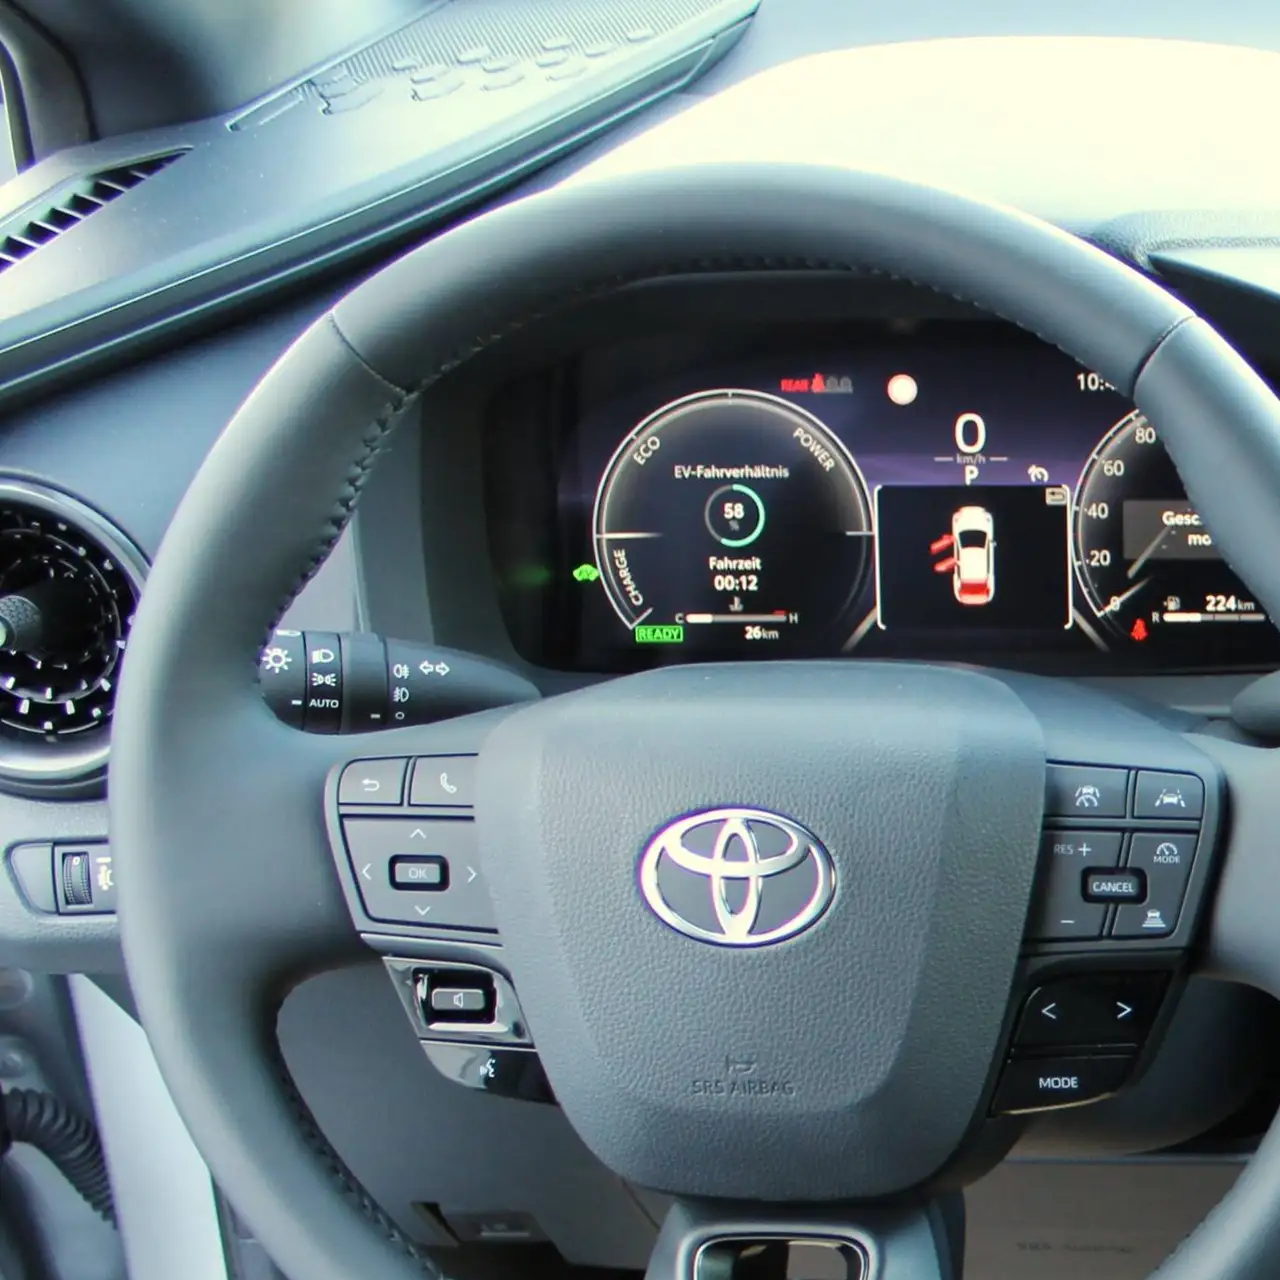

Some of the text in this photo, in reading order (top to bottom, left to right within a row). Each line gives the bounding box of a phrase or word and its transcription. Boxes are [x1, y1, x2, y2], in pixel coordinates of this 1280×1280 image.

[954, 412, 986, 454] 0
[1135, 427, 1156, 444] 80
[632, 435, 661, 465] ECO
[793, 427, 836, 472] POWER
[956, 453, 986, 464] km/h
[674, 464, 790, 480] EV-Fahrverhältnis
[965, 464, 979, 485] P
[1103, 459, 1124, 476] 60
[723, 502, 745, 519] 58
[1088, 503, 1109, 519] 40
[1162, 511, 1203, 526] Gesc
[708, 556, 762, 572] Fahrzeit
[1090, 549, 1111, 566] 20
[612, 549, 644, 606] CHARGE
[713, 575, 759, 591] 00:12
[675, 613, 684, 624] C
[788, 612, 798, 624] H
[1152, 612, 1160, 624] R
[638, 627, 682, 641] READY
[309, 698, 339, 709] AUTO
[1053, 843, 1075, 856] RES
[1153, 855, 1181, 864] MODE
[408, 866, 427, 880] OK
[1092, 881, 1134, 894] CANCEL
[692, 1080, 796, 1096] SRS AIRBAG
[1038, 1076, 1079, 1090] MODE
